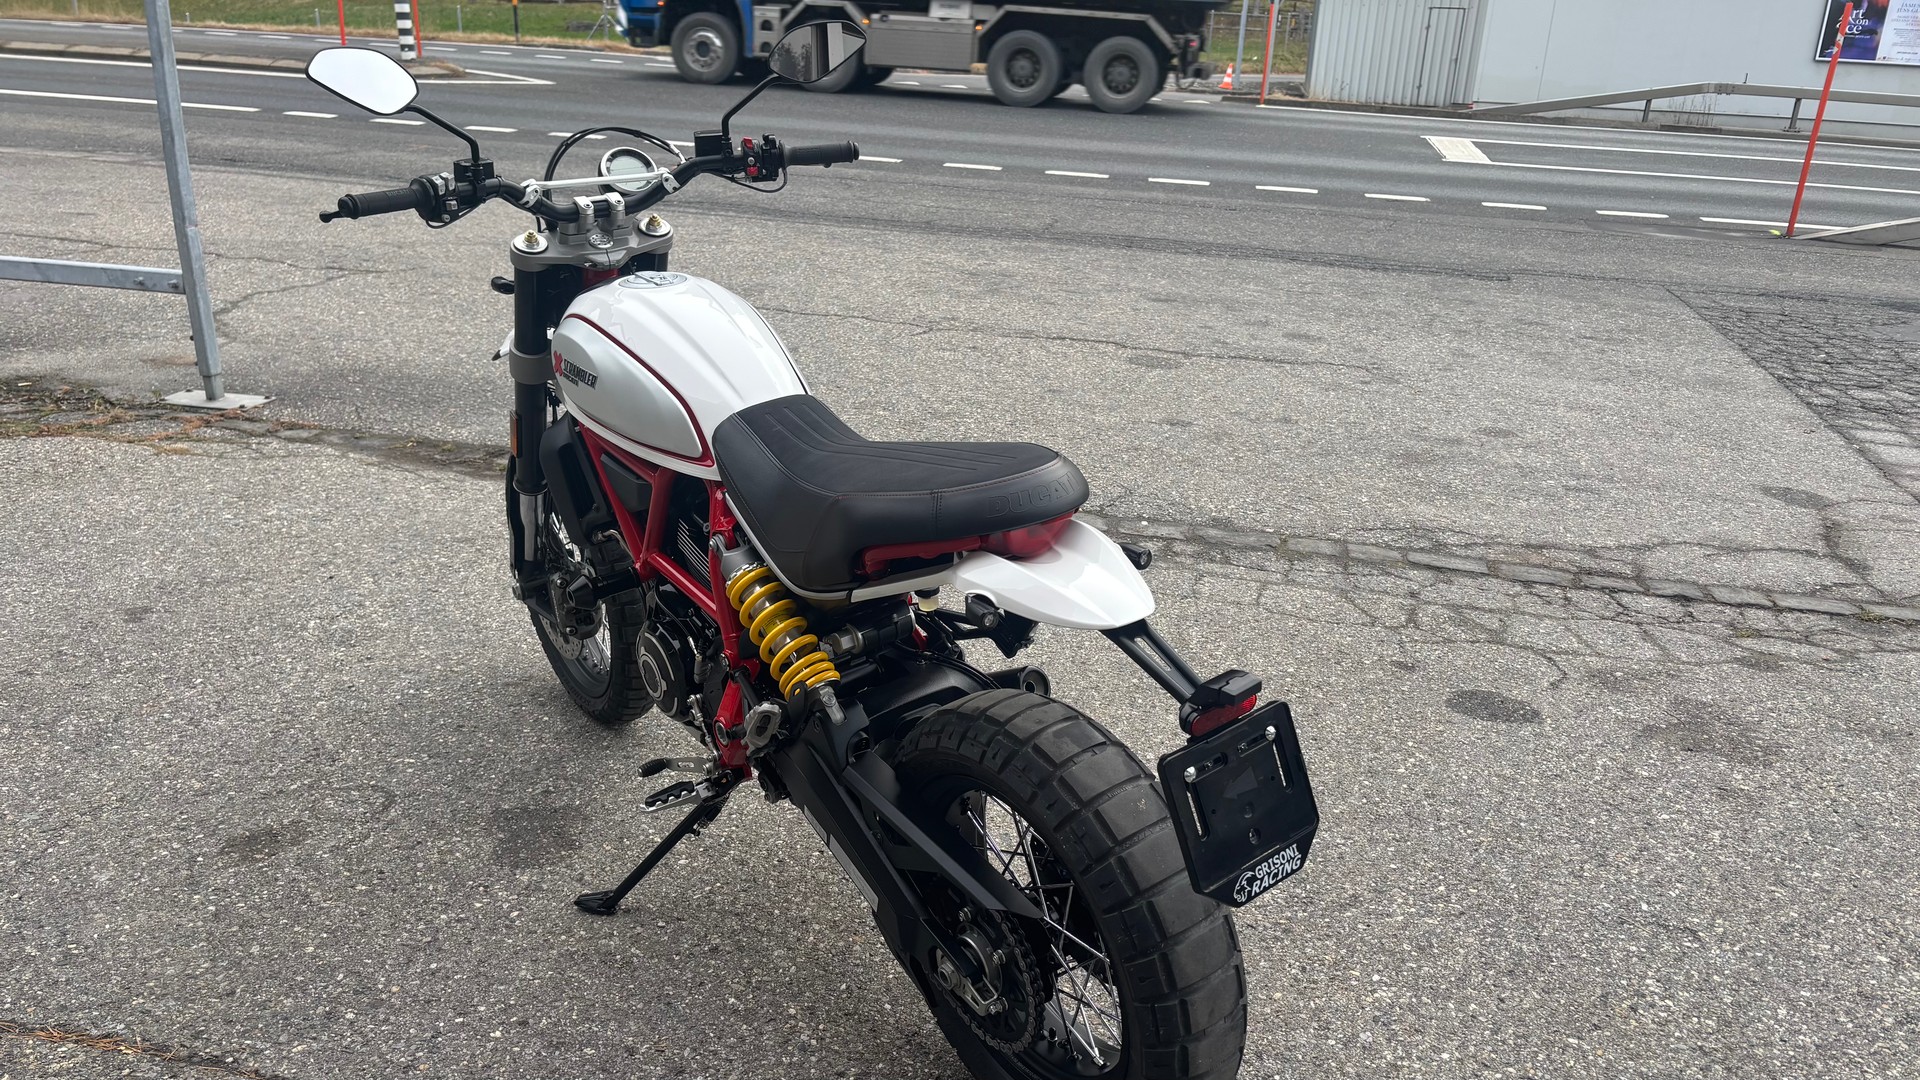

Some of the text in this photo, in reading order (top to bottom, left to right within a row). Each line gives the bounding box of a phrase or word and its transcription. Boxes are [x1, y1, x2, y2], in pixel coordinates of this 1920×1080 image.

[1856, 18, 1869, 26] on
[1251, 854, 1302, 896] RACING
[1255, 843, 1299, 879] GRISONI
